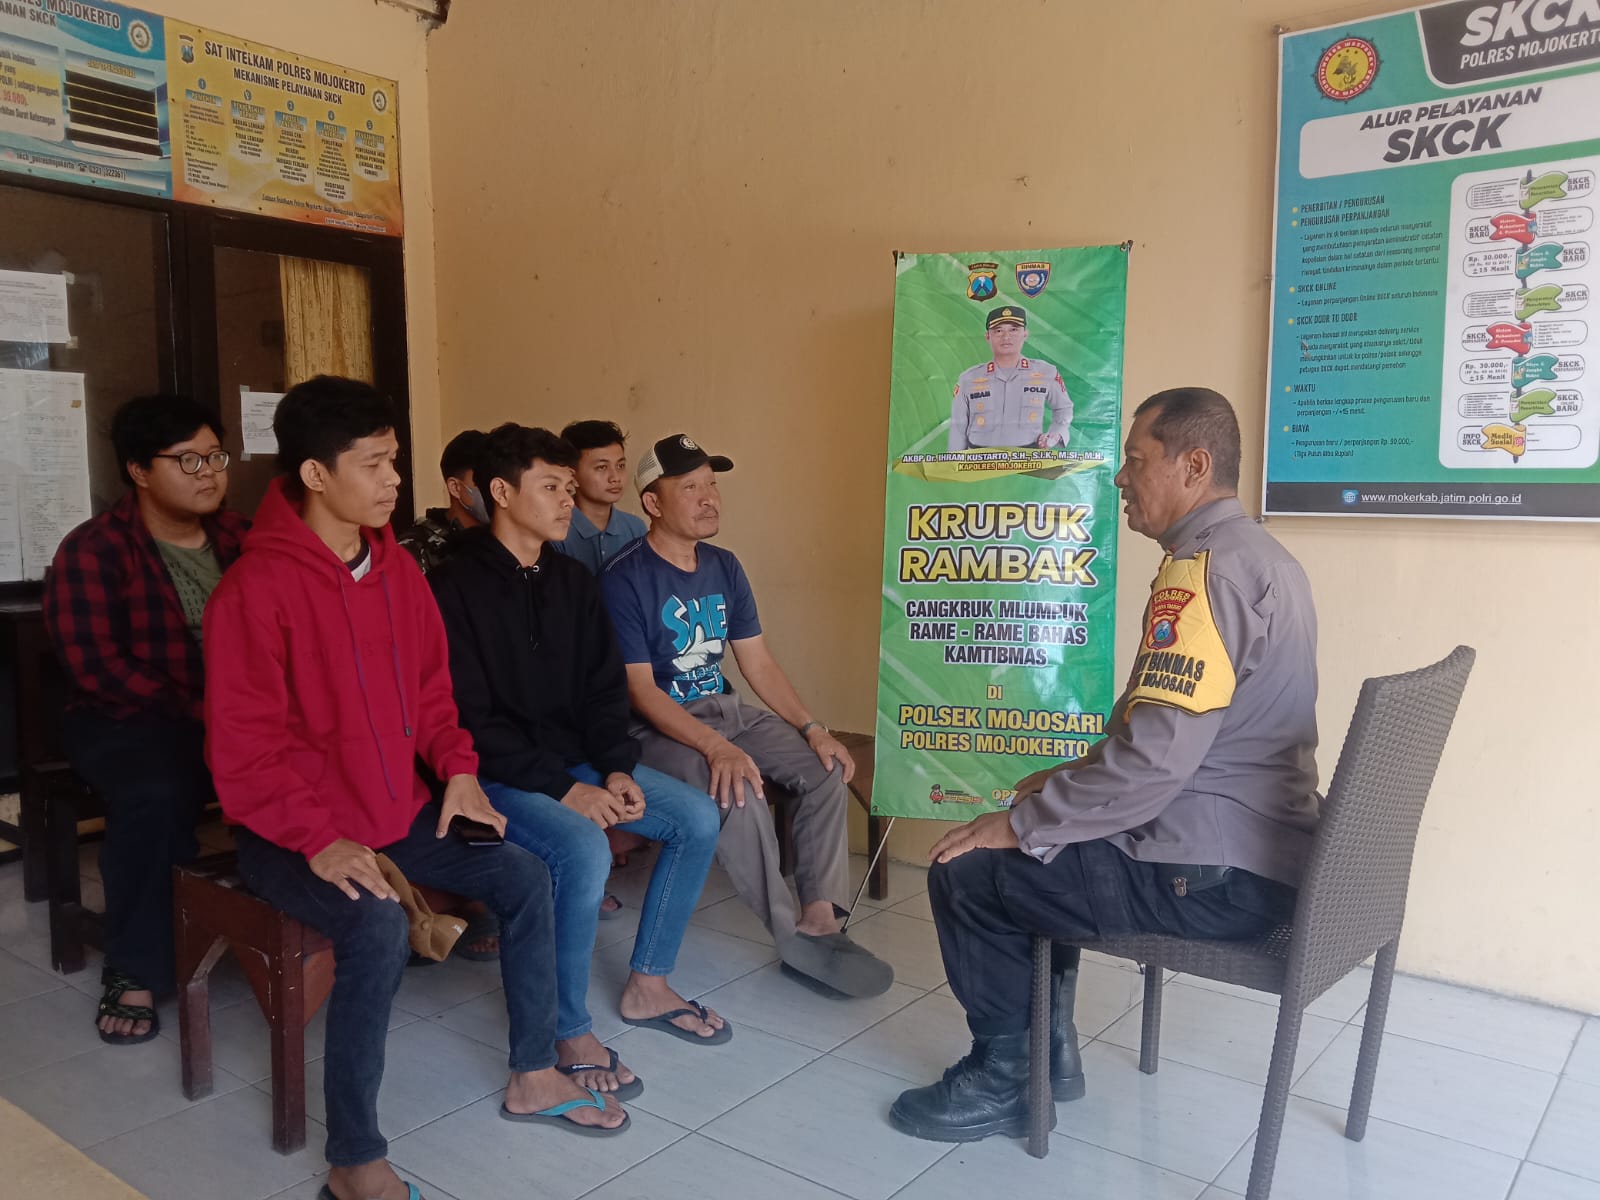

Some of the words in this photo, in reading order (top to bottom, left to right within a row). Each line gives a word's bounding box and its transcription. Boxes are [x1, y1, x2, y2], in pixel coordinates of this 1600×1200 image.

[30, 9, 56, 27] SKCK
[1460, 44, 1515, 70] POLRES
[205, 41, 223, 58] SAT
[226, 47, 274, 72] INTELKAM
[277, 61, 311, 81] POLRES
[314, 71, 366, 96] MOJOKERTO
[234, 68, 279, 89] MEKANISME
[282, 81, 322, 100] PELAYANAN
[324, 91, 343, 105] SKCK
[1360, 108, 1411, 131] ALUR
[1415, 87, 1543, 122] PELAYANAN
[1383, 113, 1512, 163] SKCK
[1567, 176, 1590, 184] SKCK
[1469, 231, 1490, 239] BARU
[1563, 247, 1585, 256] SKCK
[1565, 290, 1588, 298] SKCK
[1466, 332, 1487, 340] SKCK
[1558, 360, 1580, 368] SKCK
[1293, 383, 1316, 393] WAKTU
[1292, 424, 1311, 433] BIAYA
[902, 454, 924, 464] AKBP
[926, 454, 937, 463] Dr.
[938, 453, 965, 462] IHRAM
[966, 452, 1010, 463] KUSTARTO,
[958, 462, 996, 471] KAPOLRES
[997, 461, 1042, 470] MOJOKERTO
[907, 502, 1093, 541] KRUPUK
[899, 546, 1098, 586] RAMBAK
[906, 600, 994, 618] CANGKRUK
[999, 601, 1088, 622] MLUMPUK
[662, 594, 728, 652] SHE
[909, 622, 956, 640] RAME
[974, 623, 1023, 642] RAME
[1028, 625, 1087, 645] BAHAS
[944, 645, 1047, 666] KAMTIBMAS
[1148, 651, 1205, 682] BINMAS
[986, 685, 1003, 700] DI
[899, 704, 981, 729] POLSEK
[987, 708, 1104, 735] MOJOSARI
[901, 730, 971, 752] POLRES
[975, 734, 1090, 758] MOJOKERTO
